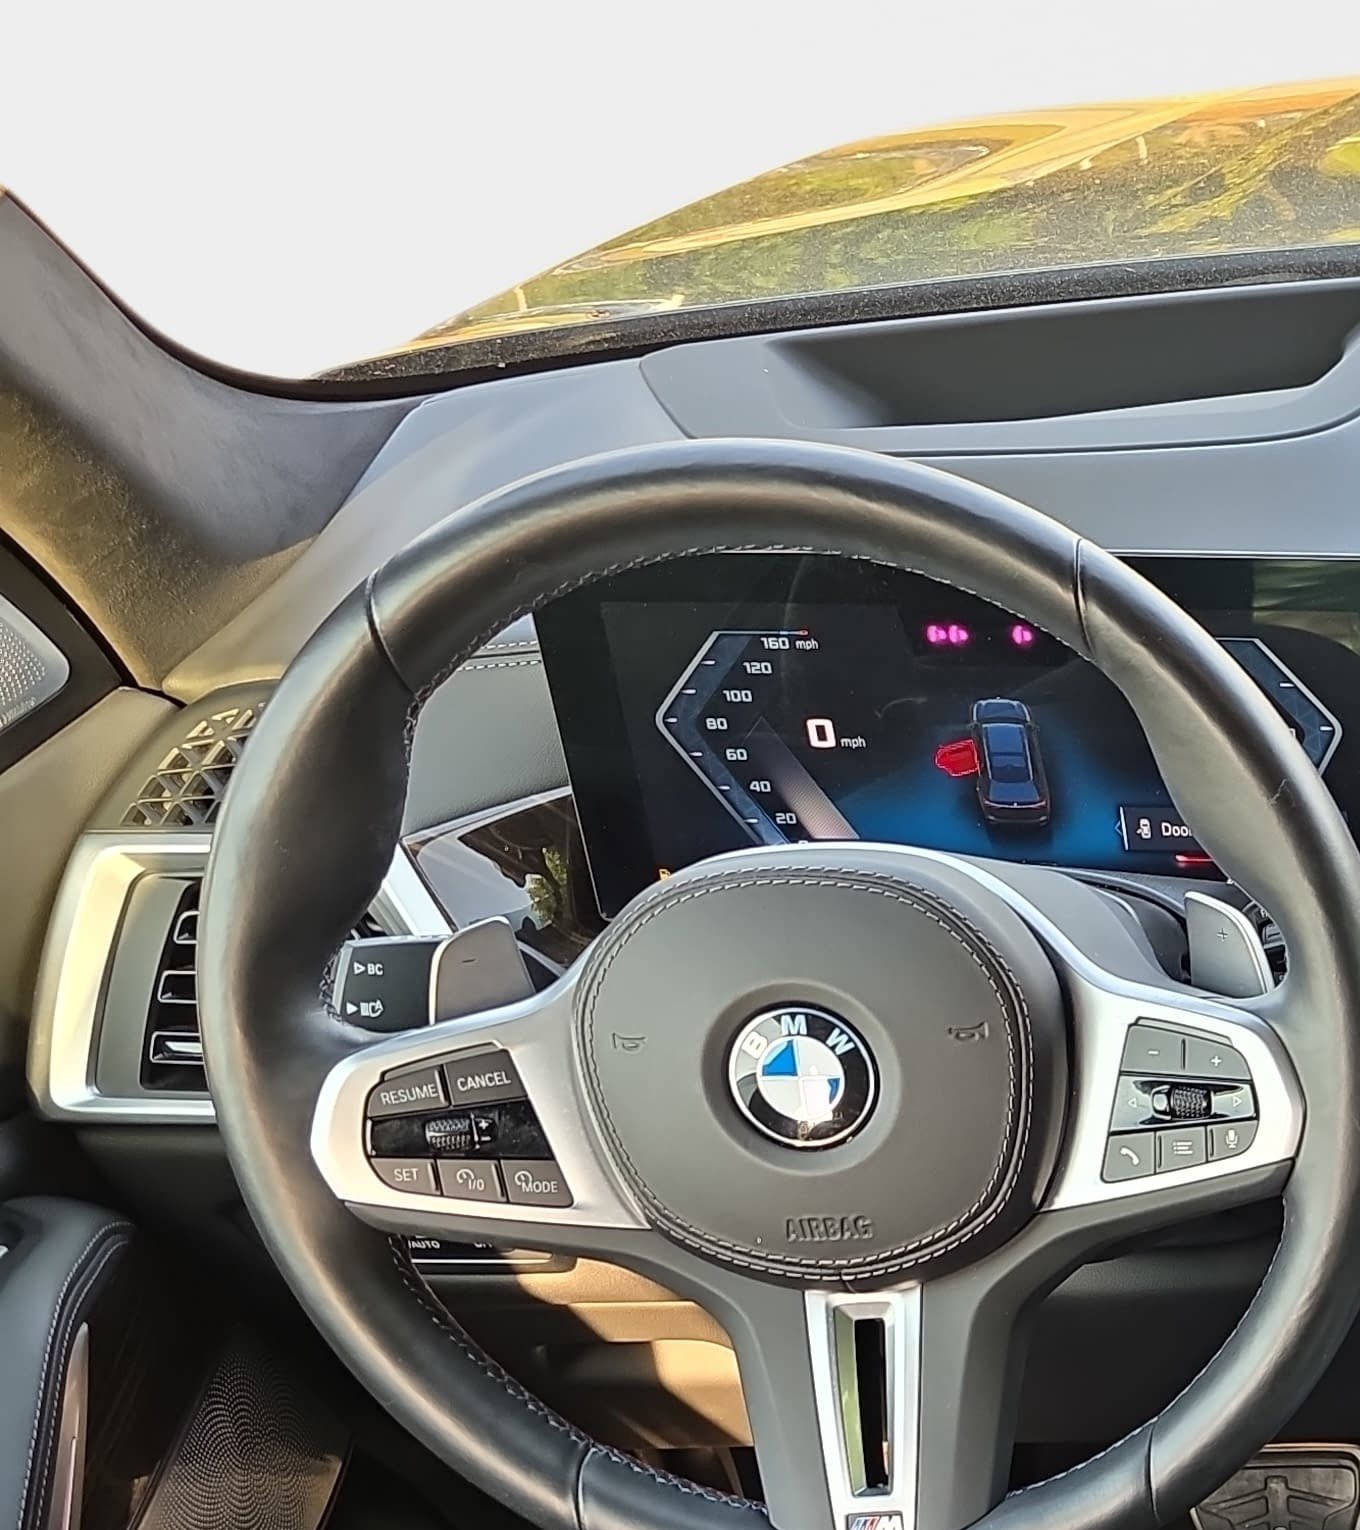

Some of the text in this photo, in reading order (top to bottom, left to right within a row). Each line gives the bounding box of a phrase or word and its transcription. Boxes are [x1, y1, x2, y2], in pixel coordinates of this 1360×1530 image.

[760, 637, 819, 651] 160 mph
[743, 661, 773, 675] 120
[723, 689, 753, 703] 100
[705, 717, 728, 731] 80
[806, 718, 867, 749] 0 mph
[725, 748, 748, 761] 60
[749, 780, 771, 793] 40
[775, 812, 797, 825] 20
[367, 963, 384, 976] BC
[741, 1014, 855, 1060] BMW
[456, 1071, 512, 1091] CANCEL
[380, 1083, 439, 1105] RESUME
[394, 1167, 419, 1182] SET
[522, 1181, 558, 1194] MODE
[785, 1215, 873, 1242] AIRBAG
